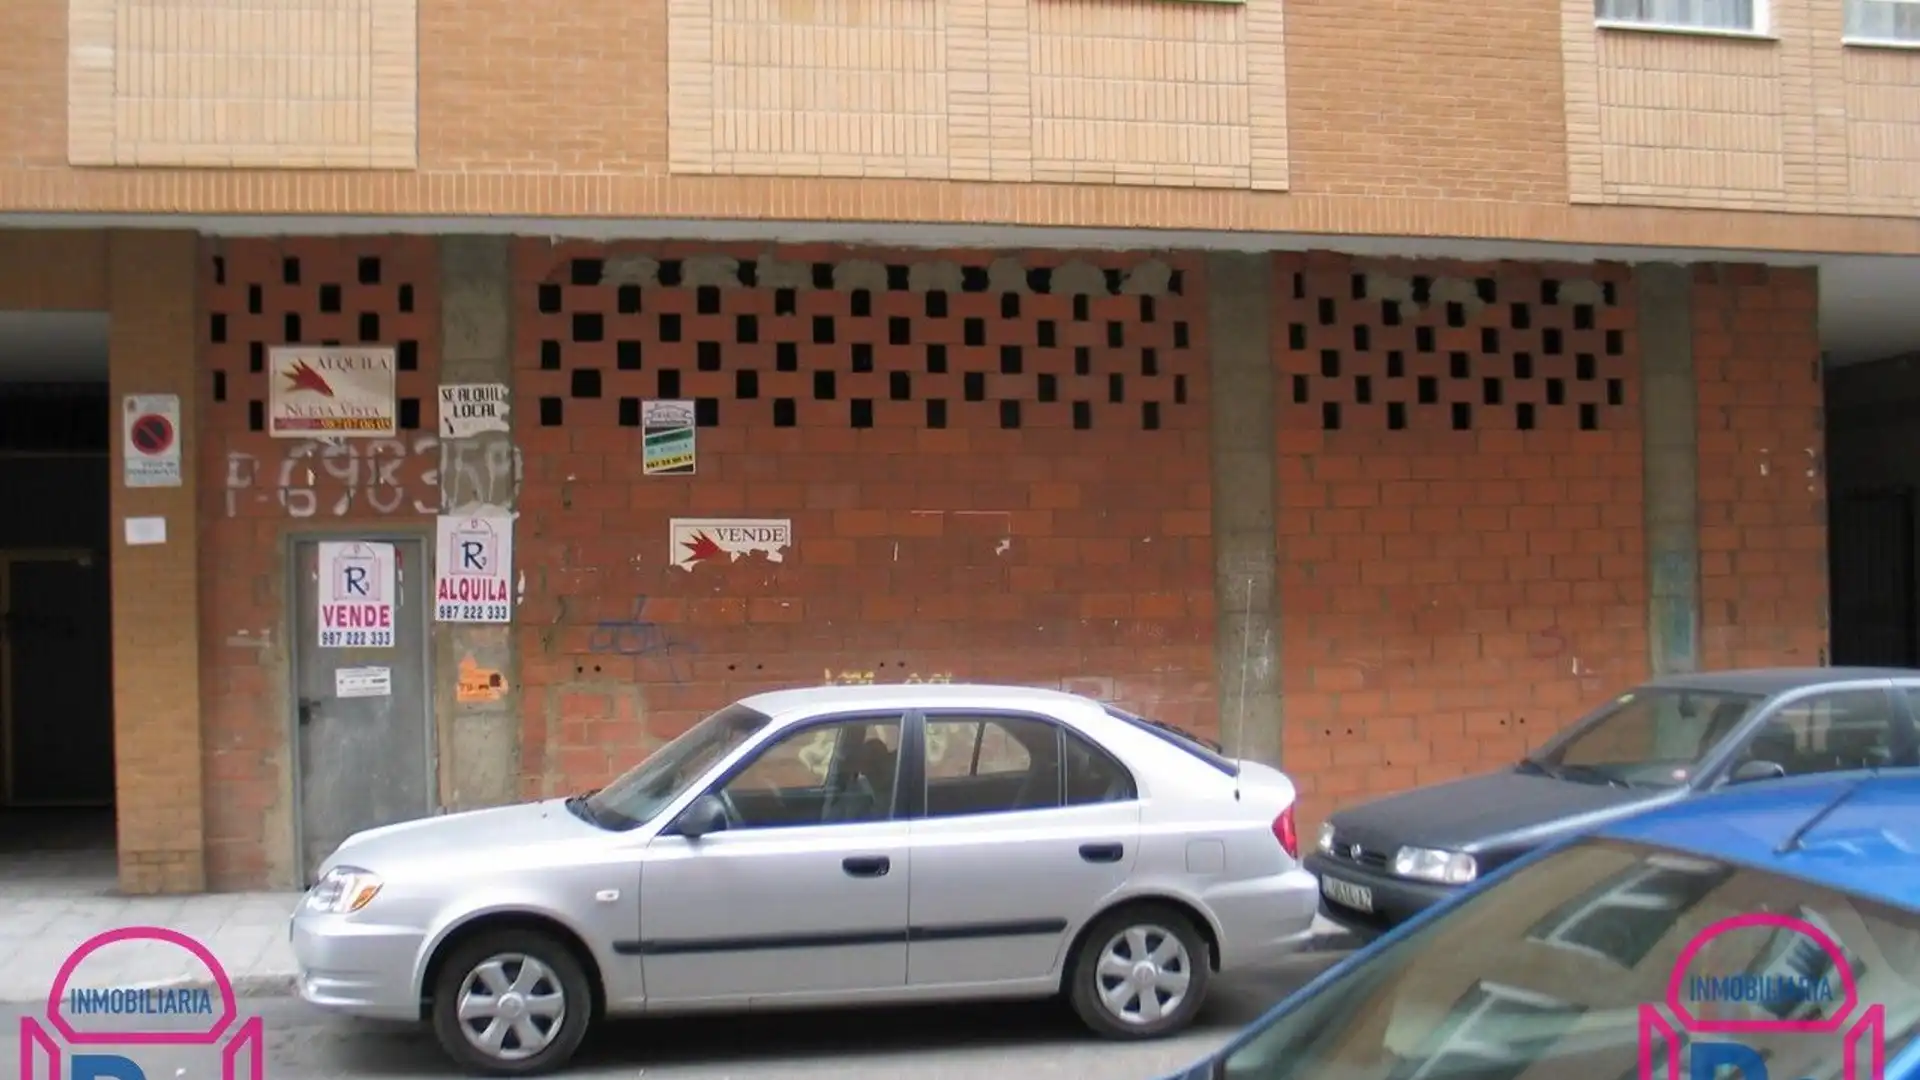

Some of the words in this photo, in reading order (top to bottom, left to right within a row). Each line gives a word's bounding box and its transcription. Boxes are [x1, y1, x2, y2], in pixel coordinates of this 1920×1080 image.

[317, 356, 389, 372] ALQUILA
[453, 403, 498, 418] LOCAL
[715, 527, 785, 543] VENDE
[439, 578, 508, 602] ALQUILA
[322, 604, 391, 629] VENDE
[439, 605, 459, 619] 987
[463, 605, 483, 619] 222
[487, 605, 507, 619] 333
[322, 632, 342, 646] 987
[346, 632, 366, 646] 222
[371, 632, 391, 646] 333
